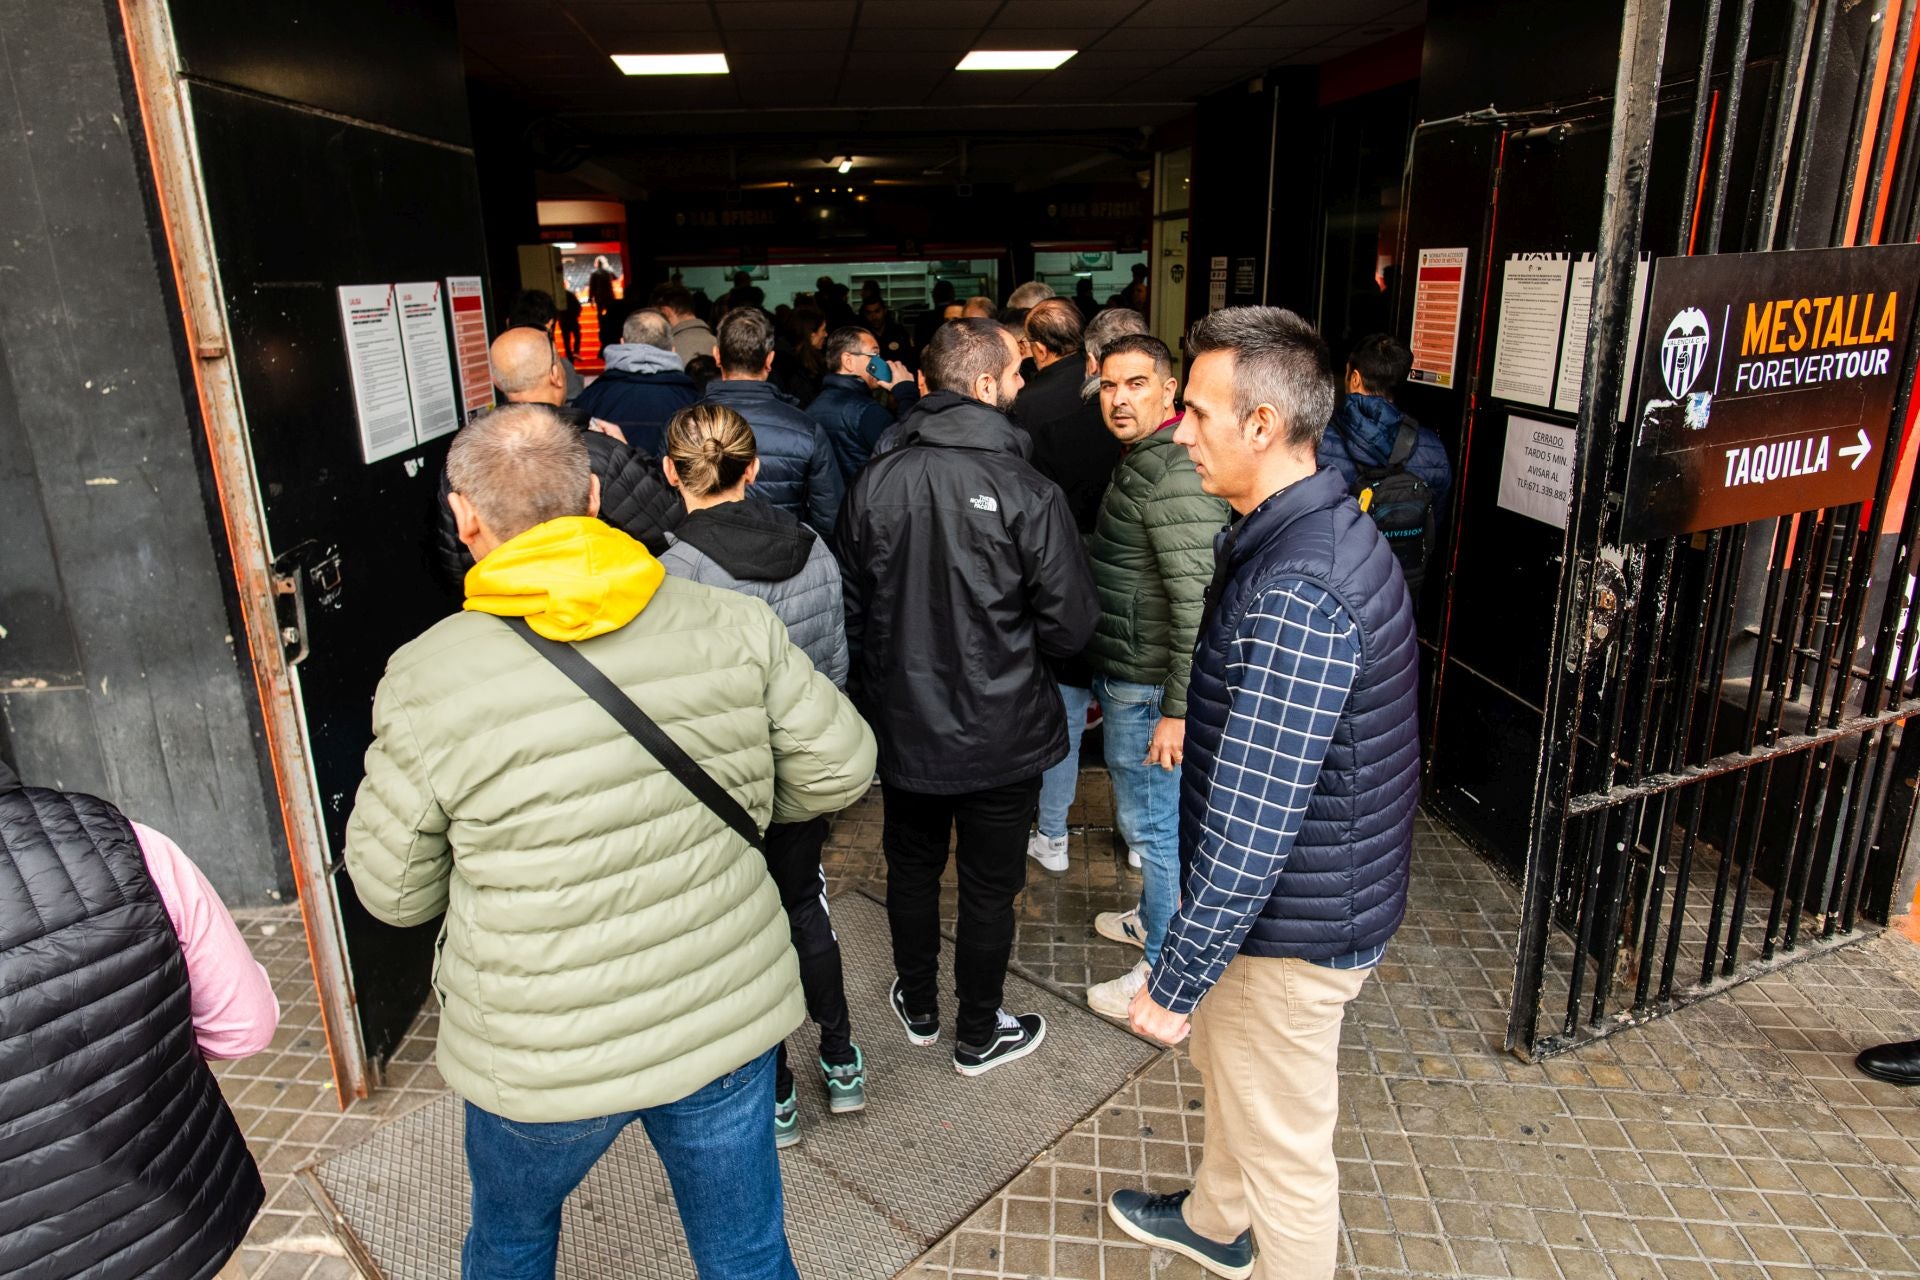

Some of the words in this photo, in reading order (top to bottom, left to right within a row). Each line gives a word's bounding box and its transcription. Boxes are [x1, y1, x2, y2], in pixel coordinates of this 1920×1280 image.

[1741, 292, 1898, 356] MESTALLA
[1667, 338, 1694, 346] VALENCIA
[1736, 348, 1890, 392] FOREVERTOUR
[1533, 431, 1564, 448] CERRADO.
[1525, 446, 1546, 460] TARDO
[1546, 452, 1551, 462] 5
[1552, 453, 1568, 467] MIN.
[1725, 435, 1829, 488] TAQUILLA
[1527, 465, 1550, 480] AVISAR
[1551, 471, 1559, 482] AL
[1380, 528, 1422, 538] AIVISION
